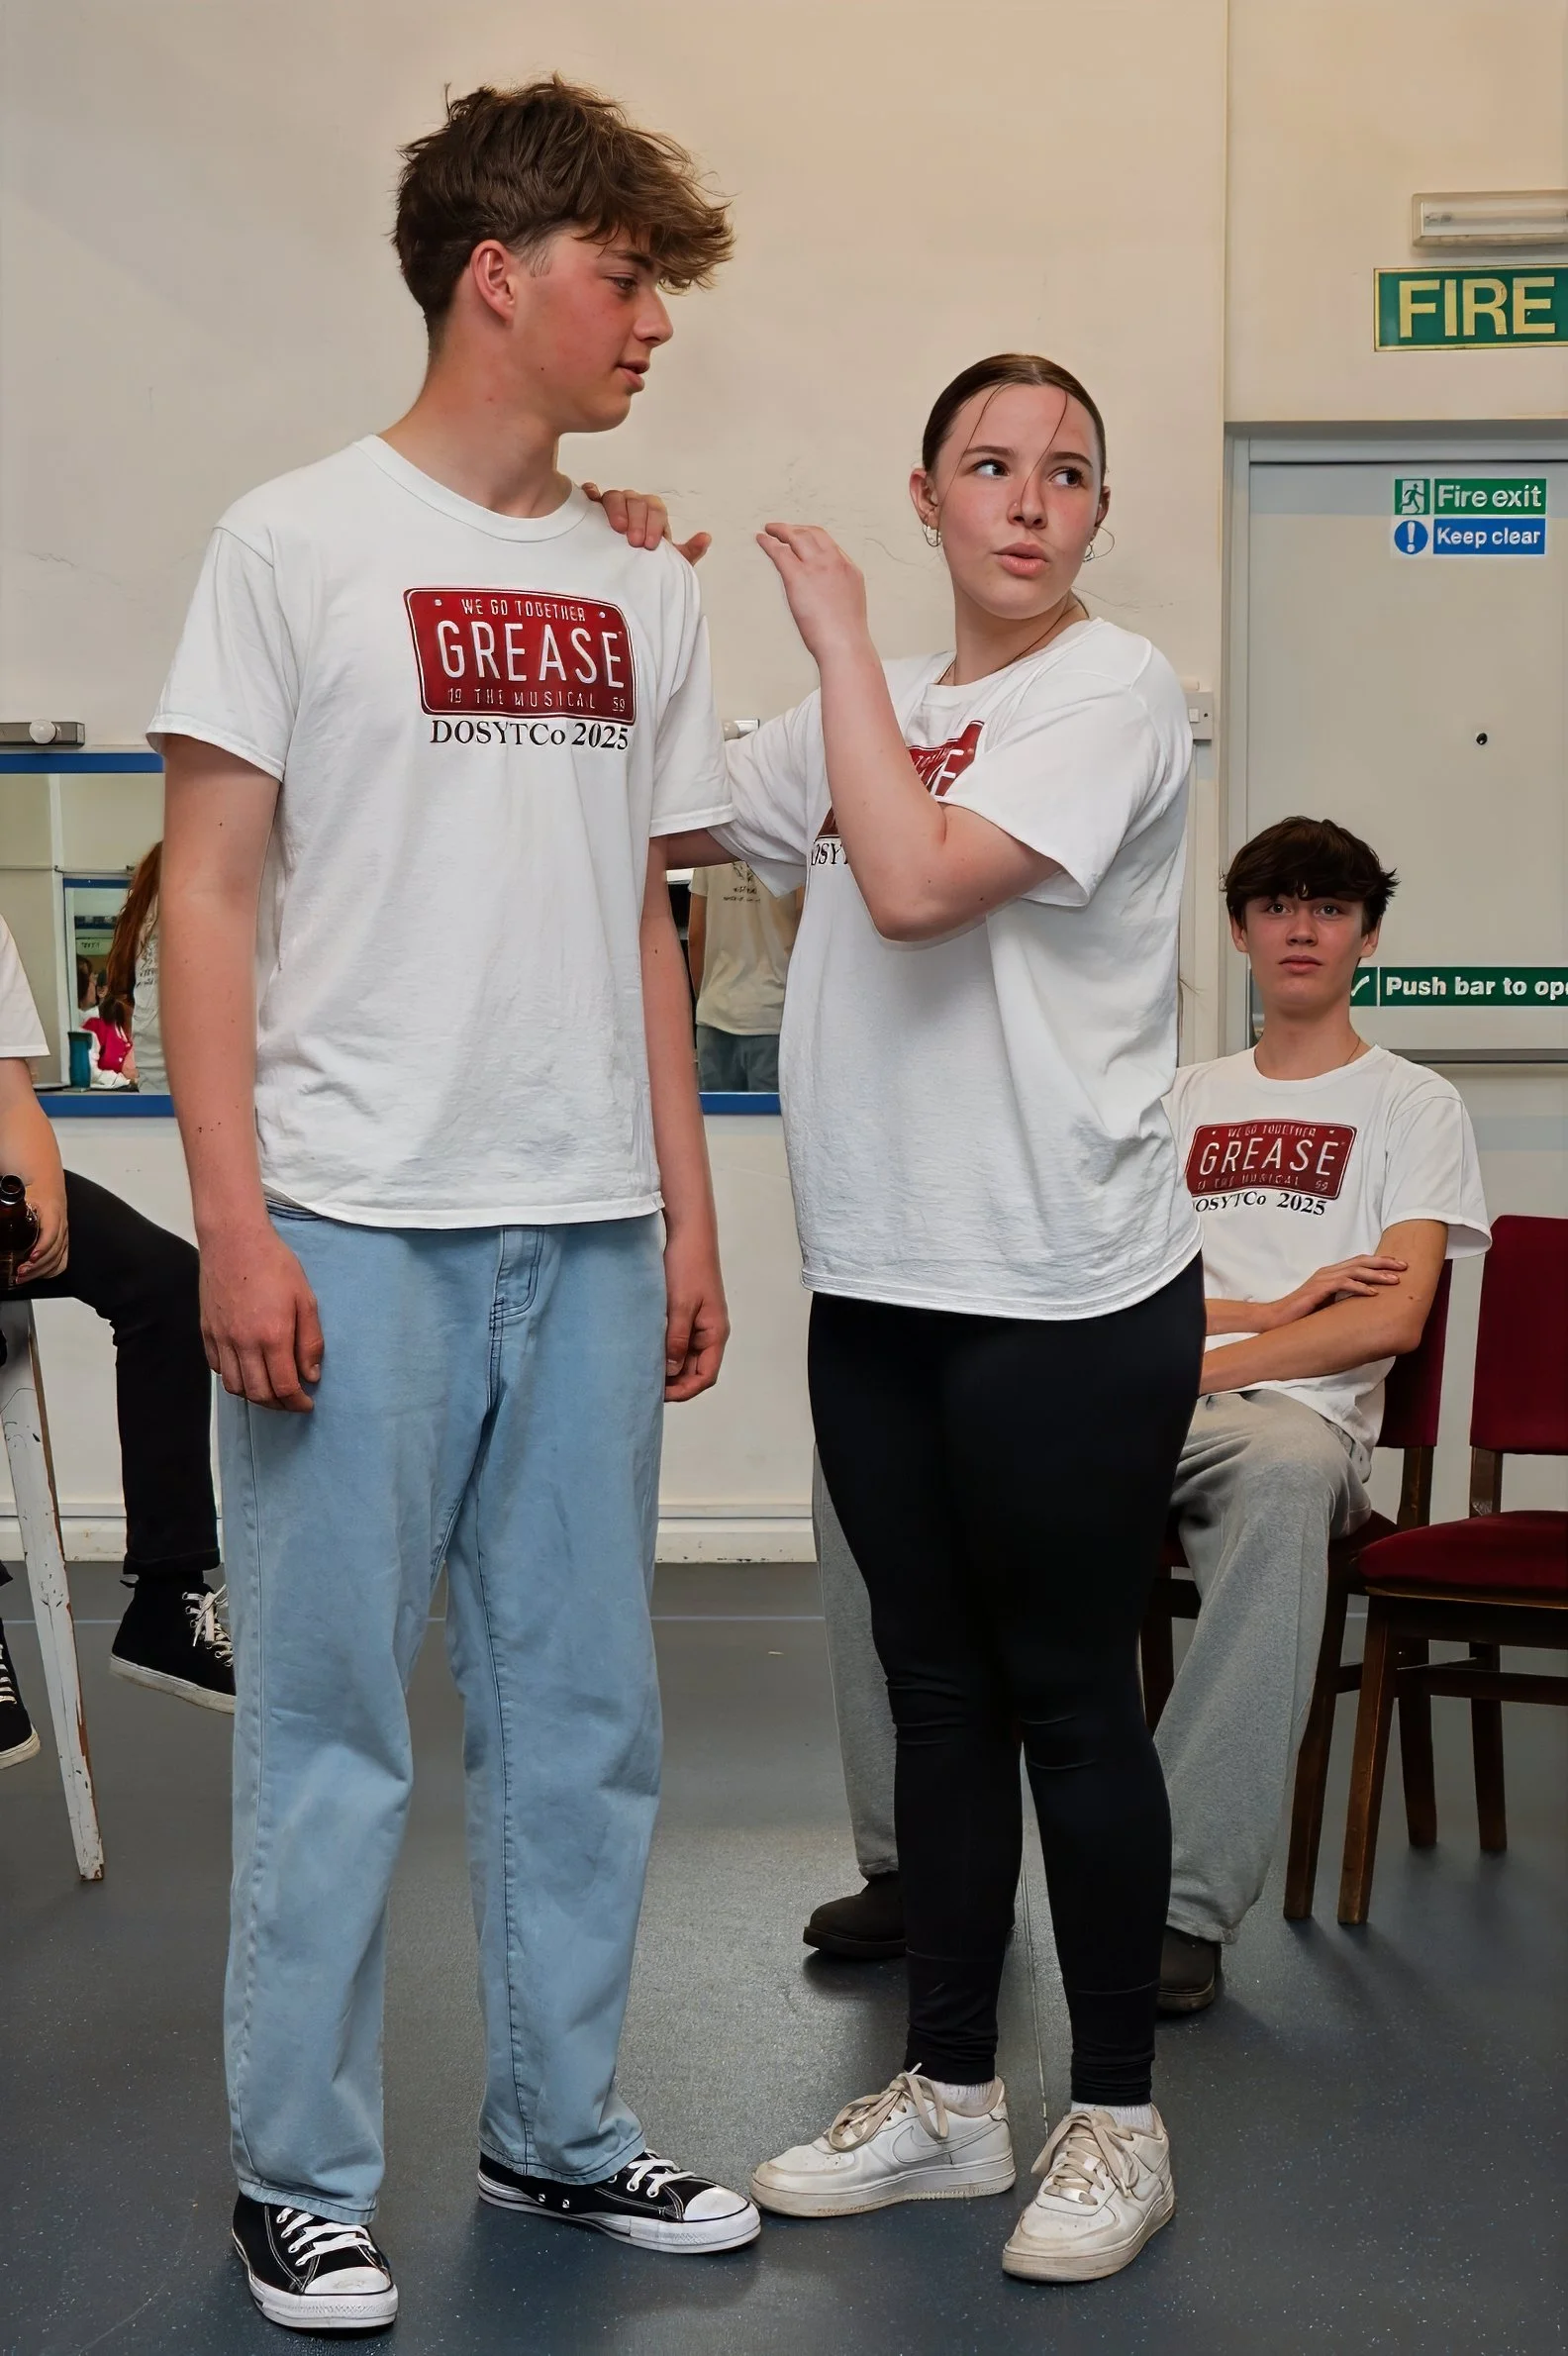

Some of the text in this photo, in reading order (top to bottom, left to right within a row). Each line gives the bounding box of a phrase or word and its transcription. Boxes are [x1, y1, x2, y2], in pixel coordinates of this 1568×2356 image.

[1399, 276, 1556, 338] FIRE
[1437, 484, 1542, 508] Fire exit
[1436, 527, 1541, 548] Keep clear
[460, 598, 586, 622] WE GO TOGETHER
[437, 620, 625, 689] GREASE
[474, 688, 504, 705] THE
[514, 690, 596, 709] MUSICAL
[430, 720, 629, 750] DOSYTCo 2025
[1386, 976, 1568, 1000] Push bar to op
[1199, 1137, 1339, 1176] GREASE
[1192, 1191, 1327, 1216] OSYTCo 2025
